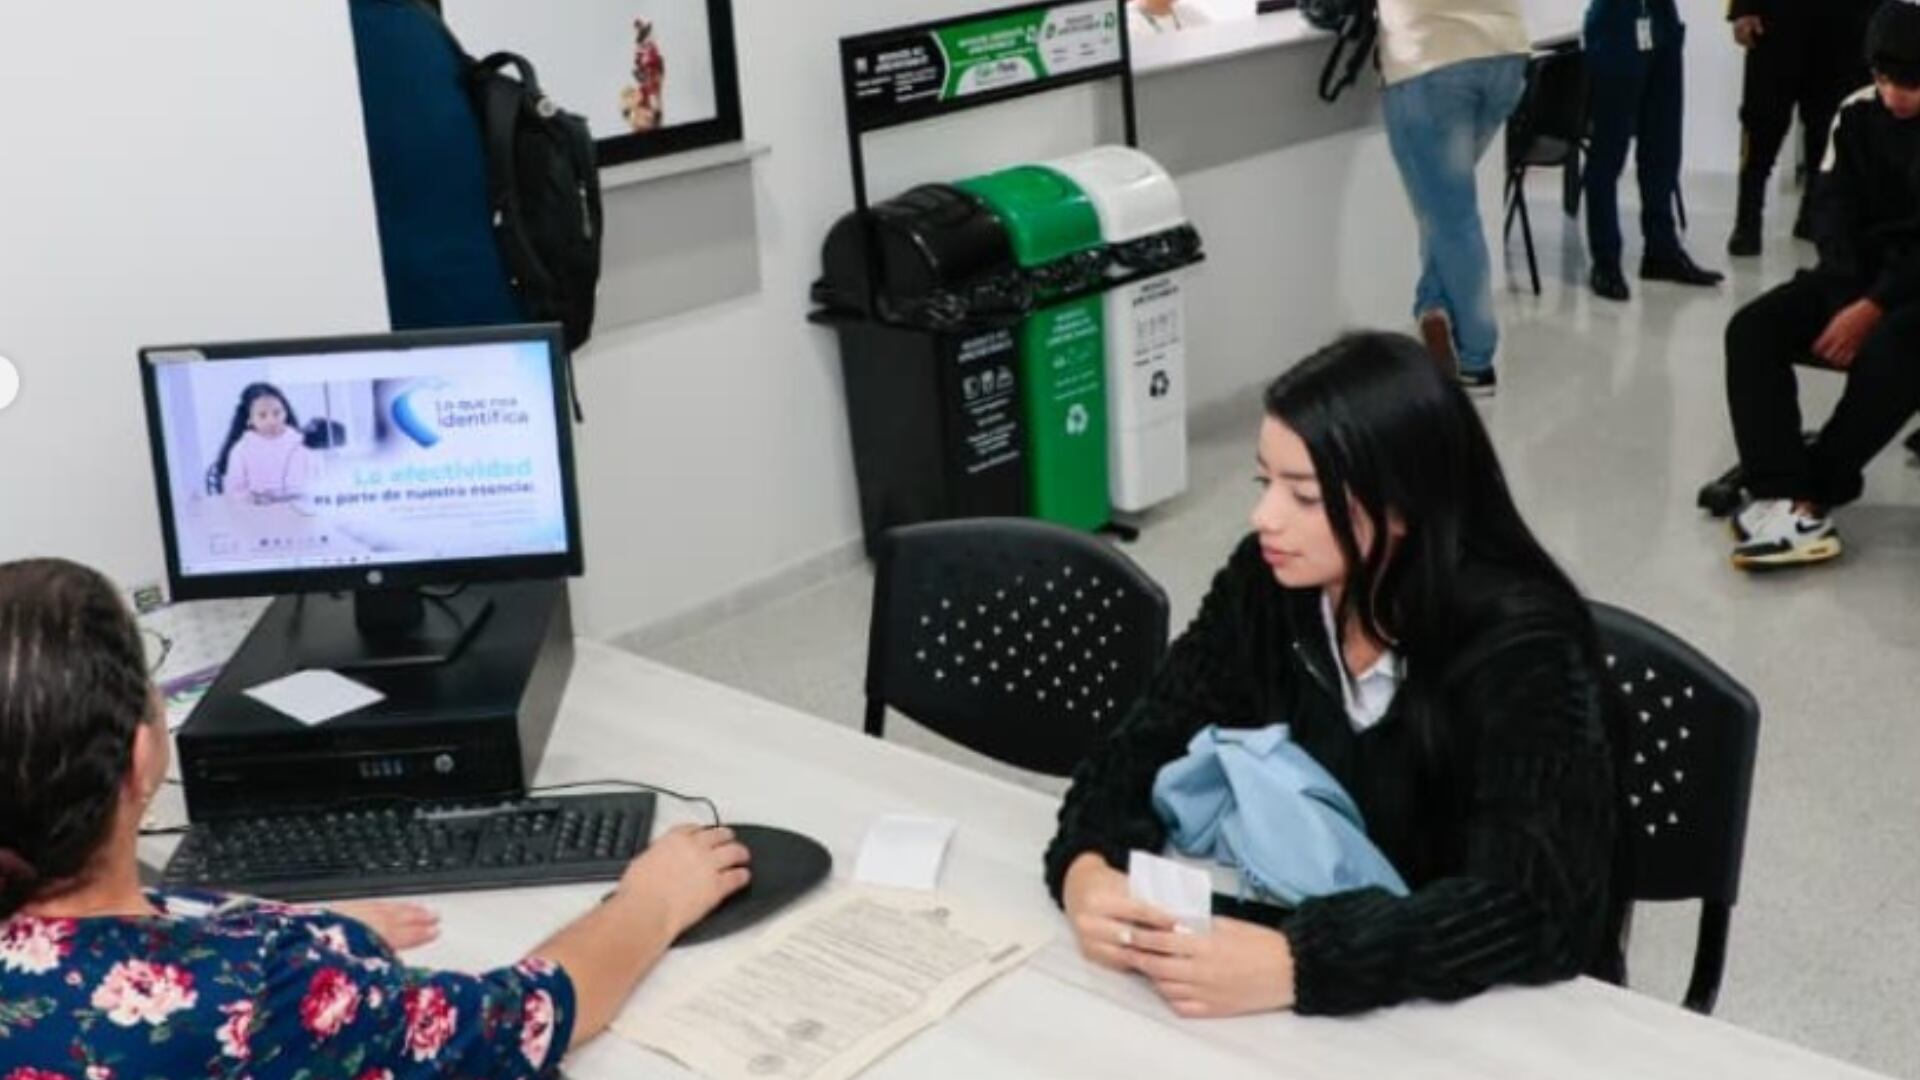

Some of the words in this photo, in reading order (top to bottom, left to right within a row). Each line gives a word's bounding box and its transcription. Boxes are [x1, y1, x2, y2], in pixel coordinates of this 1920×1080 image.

[437, 409, 529, 429] identifica
[336, 490, 377, 508] parte
[382, 487, 401, 502] de
[405, 486, 467, 501] nuestra
